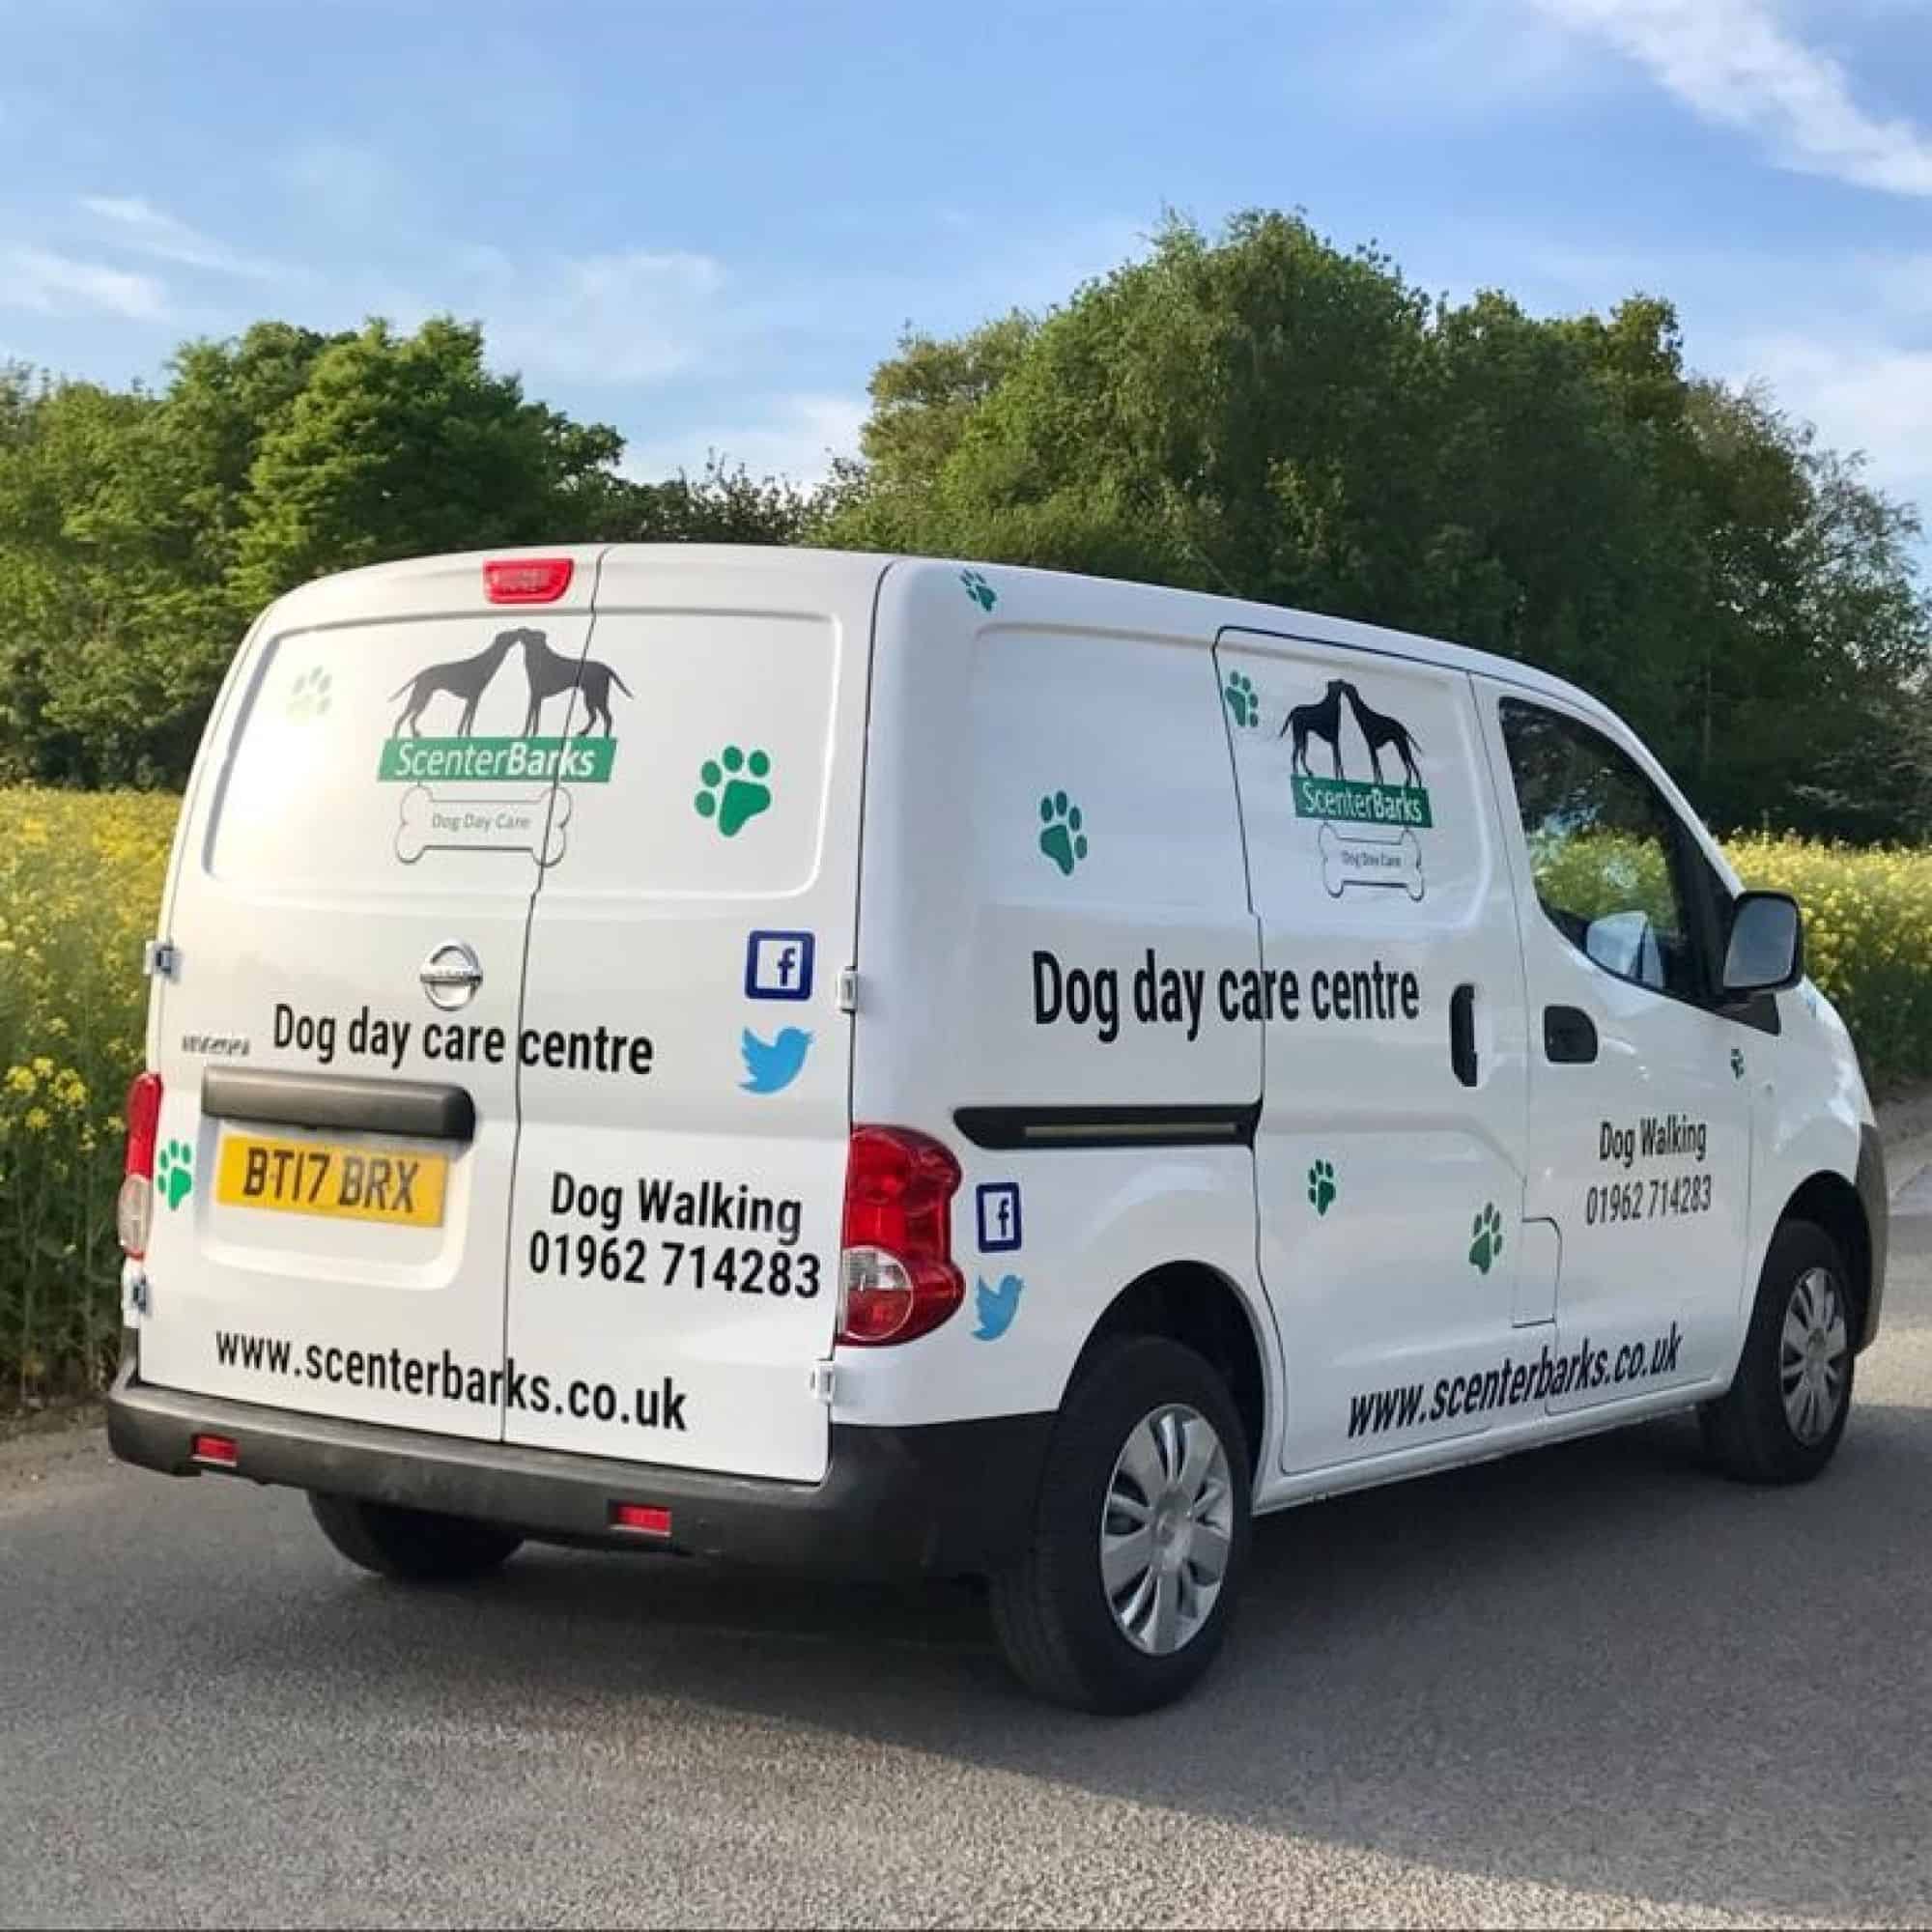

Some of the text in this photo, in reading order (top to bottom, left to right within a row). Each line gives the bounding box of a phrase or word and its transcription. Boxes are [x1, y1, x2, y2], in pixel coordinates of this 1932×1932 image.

[395, 741, 596, 778] ScenterBarks
[432, 811, 458, 833] Dog
[496, 812, 531, 831] Care
[1303, 781, 1423, 823] ScenterBarks
[1033, 948, 1420, 1043] Dog day care centre
[273, 1003, 336, 1065] Dog
[349, 1006, 412, 1069] day
[423, 1022, 505, 1064] care
[519, 1026, 654, 1075] centre
[1599, 1114, 1708, 1168] Dog Walking
[242, 1147, 420, 1214] BT17 BRX
[552, 1172, 802, 1246] Dog Walking
[1585, 1174, 1712, 1226] 01962 714283
[528, 1230, 821, 1299] 01962 714283
[215, 1329, 687, 1432] www.scenterbarks.co.uk
[1348, 1321, 1684, 1438] www.scenterbarks.co.uk
